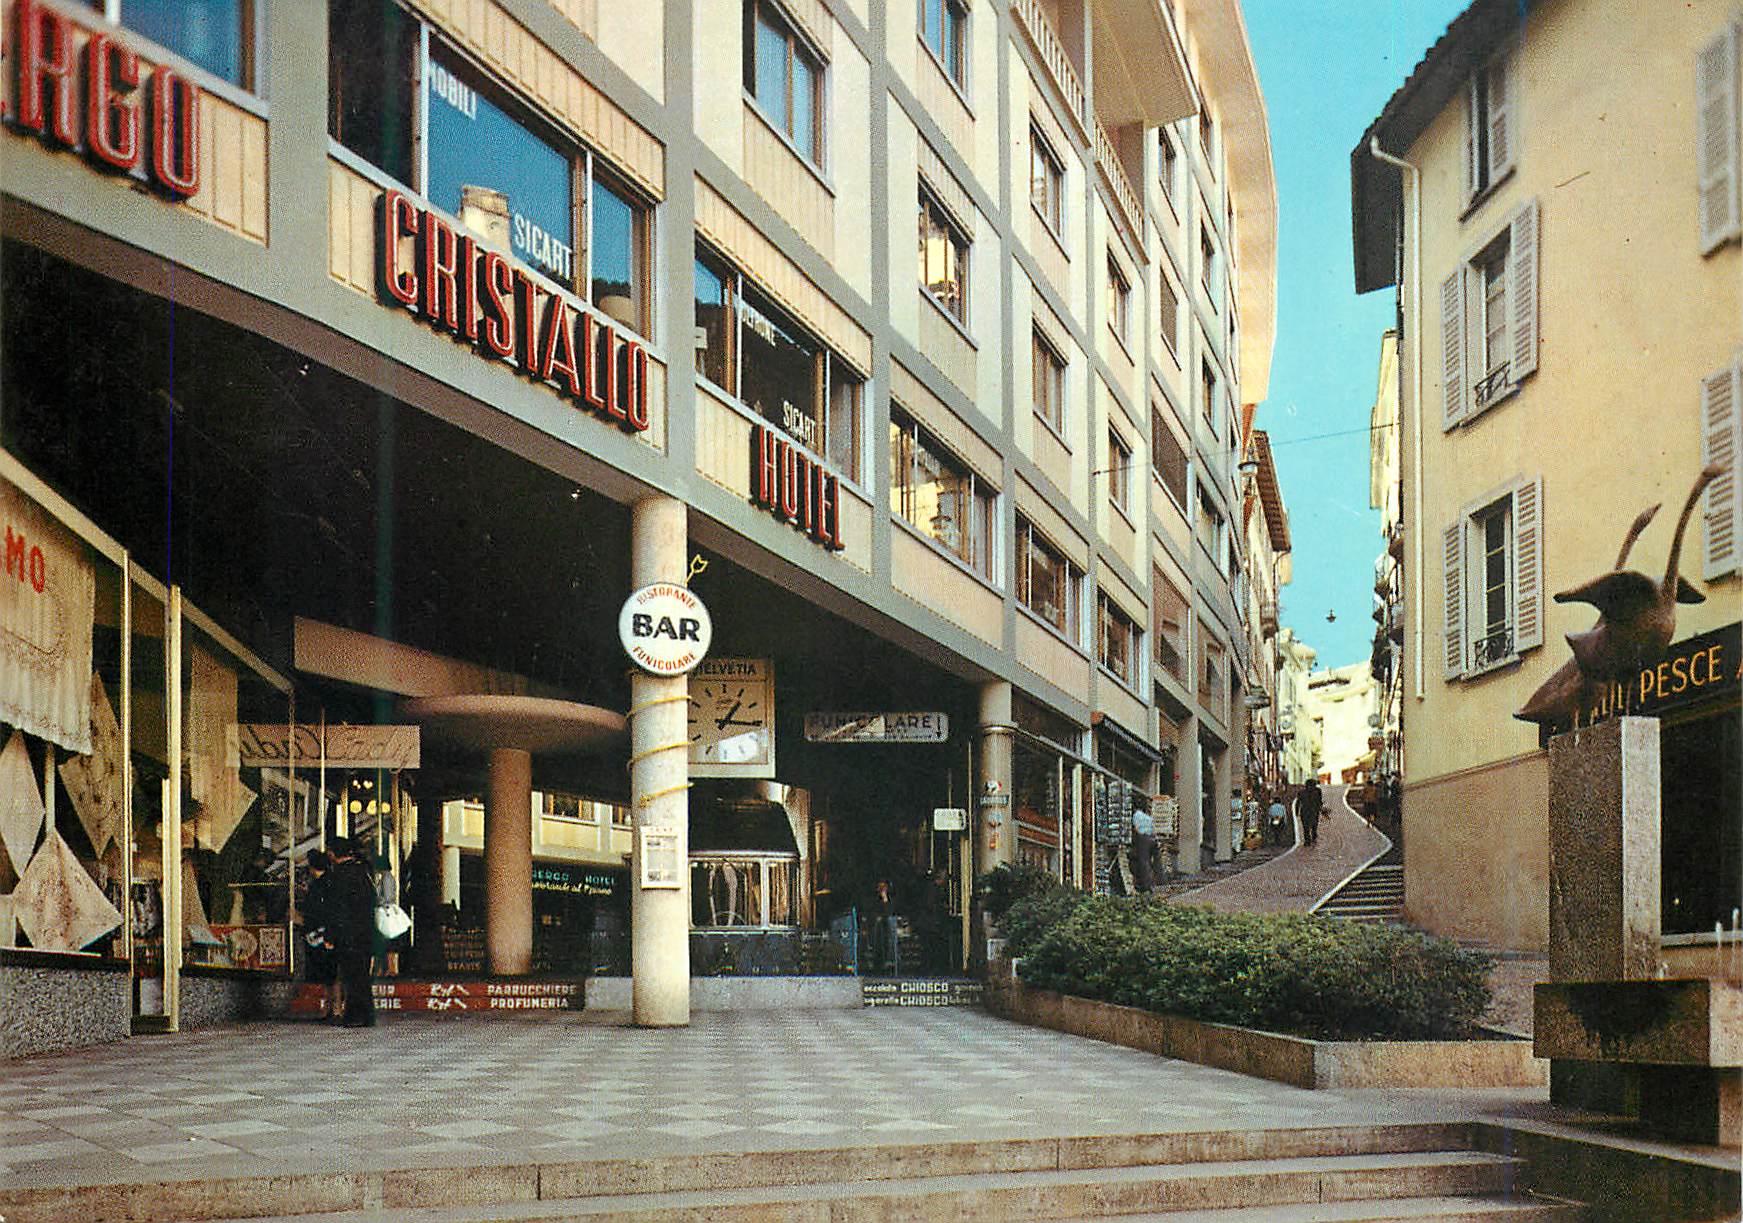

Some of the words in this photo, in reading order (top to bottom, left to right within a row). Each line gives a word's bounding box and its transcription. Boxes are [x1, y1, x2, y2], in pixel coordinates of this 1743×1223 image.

[17, 0, 201, 197] RGO
[514, 213, 572, 281] SICART
[385, 187, 650, 431] CRISTALLO
[782, 399, 817, 448] SICART
[758, 423, 846, 551] HOTEL
[5, 524, 46, 594] MO
[636, 586, 697, 609] RISTORANTE
[632, 613, 700, 642] BAR
[632, 645, 696, 671] FUNICOLARE
[1639, 644, 1724, 705] PESCE
[807, 713, 932, 729] FUNICLARE
[371, 984, 395, 996] EUR
[900, 981, 949, 993] CHIOSCO
[900, 995, 949, 1006] CHIOSCO
[373, 998, 401, 1009] ERIE
[490, 998, 569, 1009] PROFUMERIA
